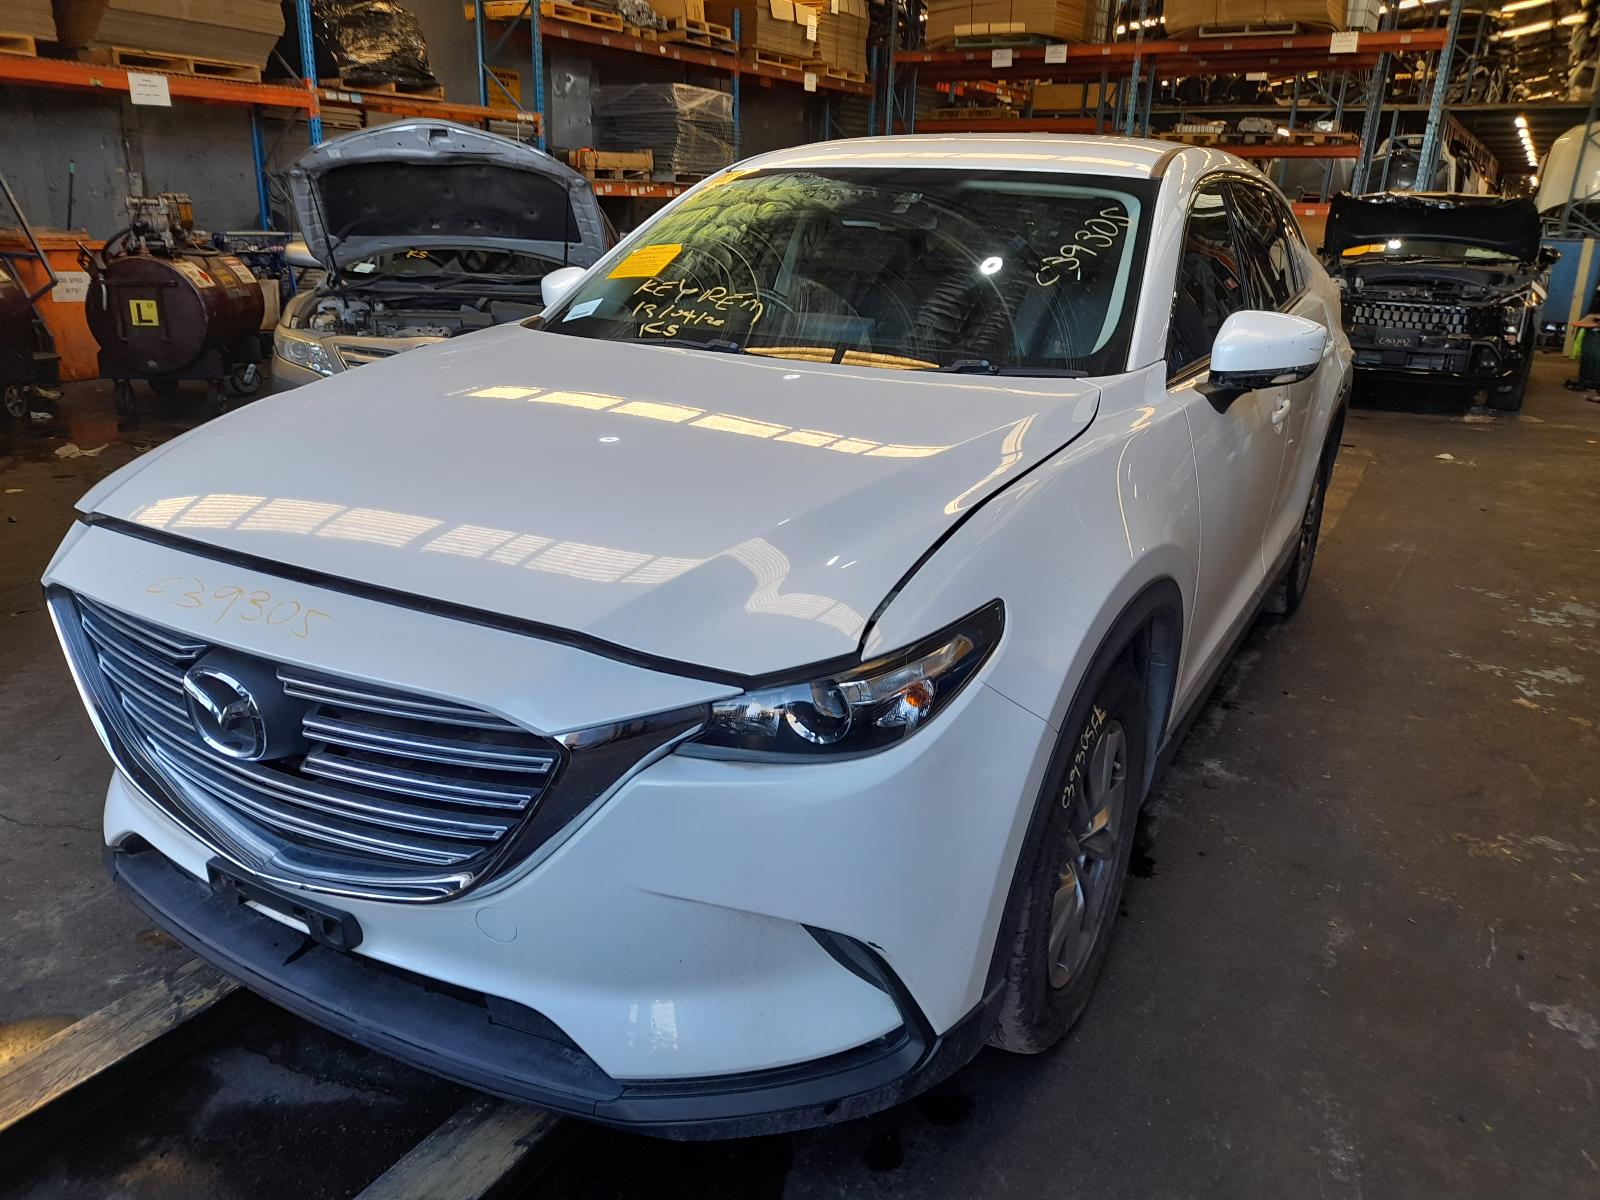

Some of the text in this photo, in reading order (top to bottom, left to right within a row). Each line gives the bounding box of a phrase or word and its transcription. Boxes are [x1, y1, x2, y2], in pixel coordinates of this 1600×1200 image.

[1035, 206, 1133, 287] C39305
[632, 278, 699, 303] KEY
[135, 302, 154, 324] L
[147, 576, 332, 639] C39305
